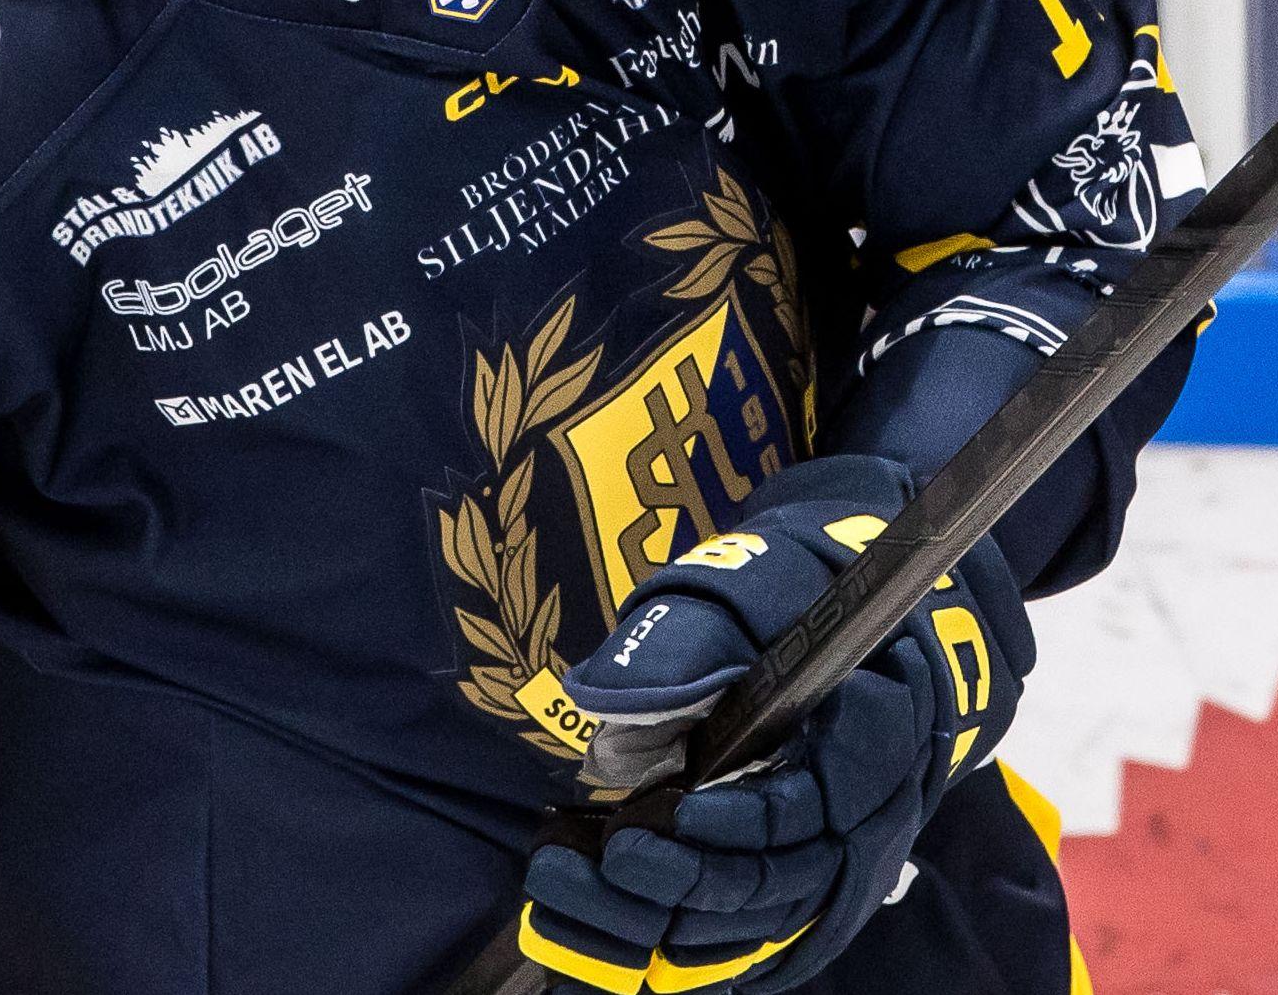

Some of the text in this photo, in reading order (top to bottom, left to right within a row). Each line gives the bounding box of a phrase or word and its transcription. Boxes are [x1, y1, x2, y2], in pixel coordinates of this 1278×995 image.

[51, 187, 144, 247] STÅL &
[70, 123, 282, 267] BRANDTEKNIK AB
[128, 290, 251, 352] LMJ AB
[197, 310, 412, 421] MAREN EL AB
[613, 603, 671, 668] CCM
[543, 697, 598, 743] SOD
